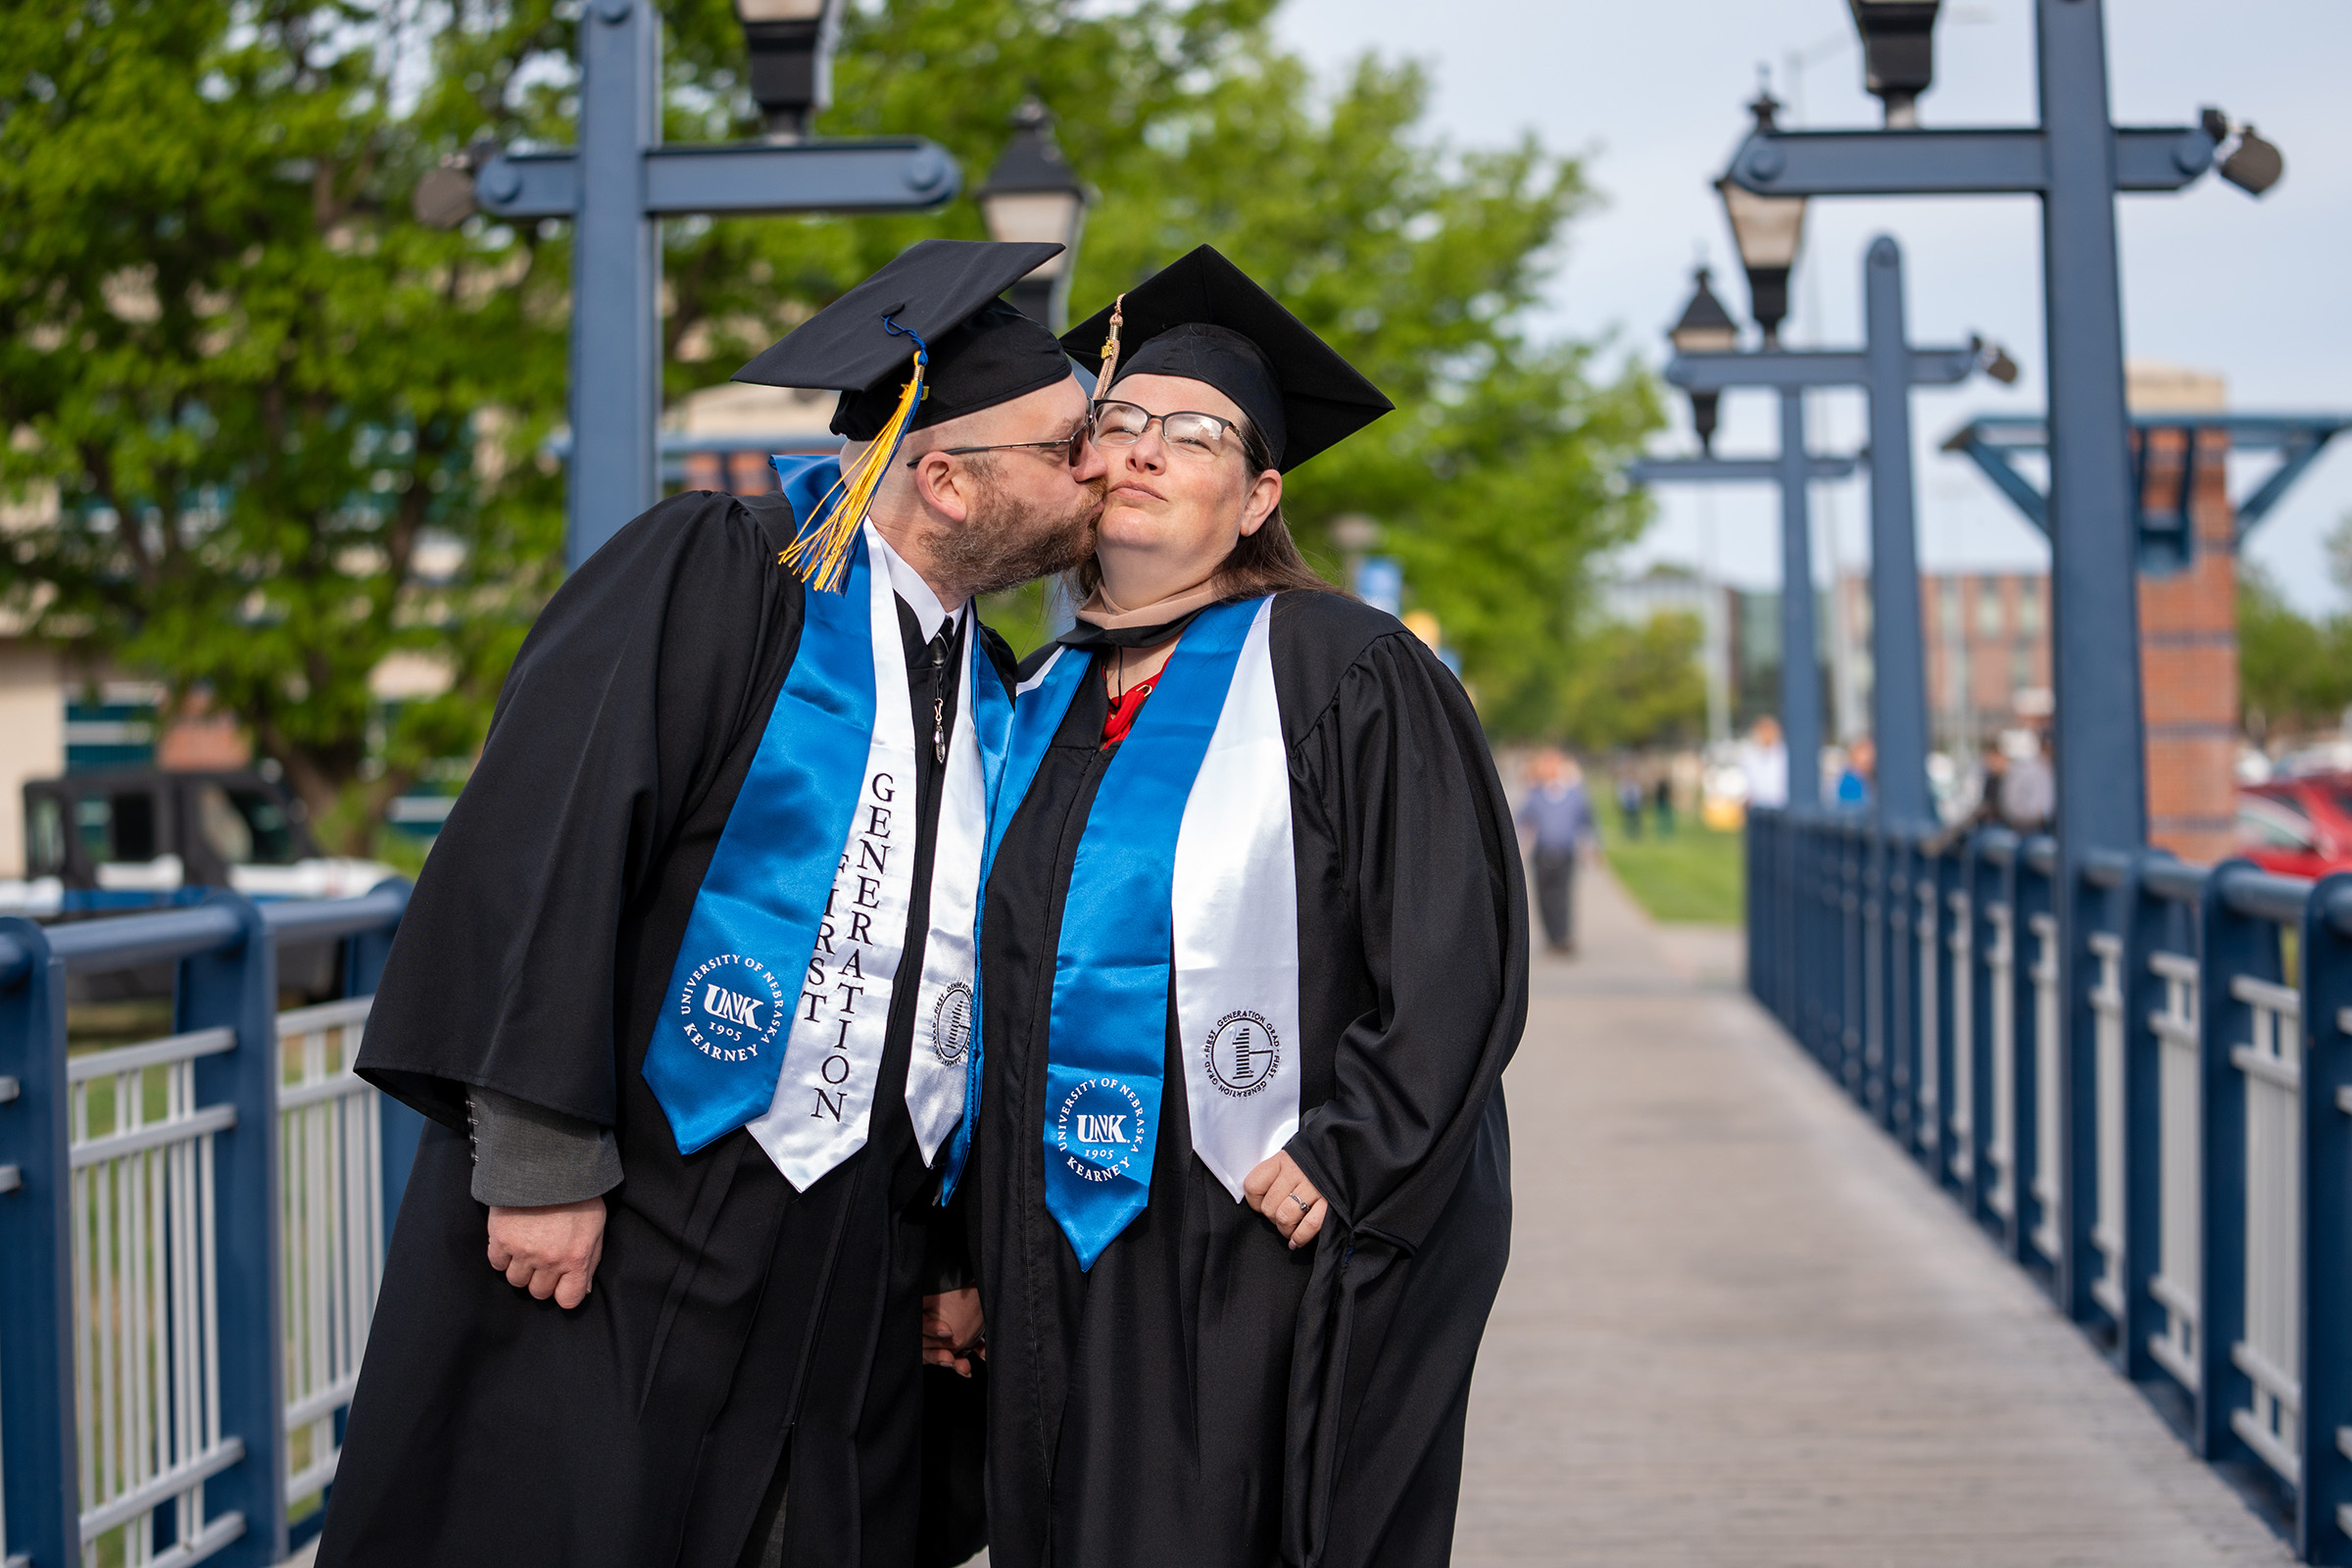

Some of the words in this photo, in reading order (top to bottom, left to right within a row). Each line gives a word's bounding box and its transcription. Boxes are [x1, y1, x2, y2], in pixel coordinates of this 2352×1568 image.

[810, 772, 896, 1122] GENERATION
[681, 954, 741, 1015] UNIVERSITY
[744, 957, 764, 972] OF
[760, 971, 784, 1044] NEBRASKA
[683, 1023, 759, 1062] KEARNEY
[709, 1021, 743, 1042] 1905
[1203, 1029, 1216, 1054] FIRST
[1217, 1010, 1266, 1027] GENERATION
[1266, 1023, 1280, 1048] GRAD
[1204, 1061, 1218, 1086] GRAD
[1268, 1054, 1281, 1079] FIRST
[1218, 1080, 1267, 1098] GENERATION
[1057, 1079, 1097, 1152] UNIVERSITY
[1101, 1077, 1118, 1089] OF
[1119, 1084, 1146, 1153] NEBRASKA
[1084, 1149, 1114, 1160] 1905
[1066, 1156, 1131, 1182] KEARNEY
